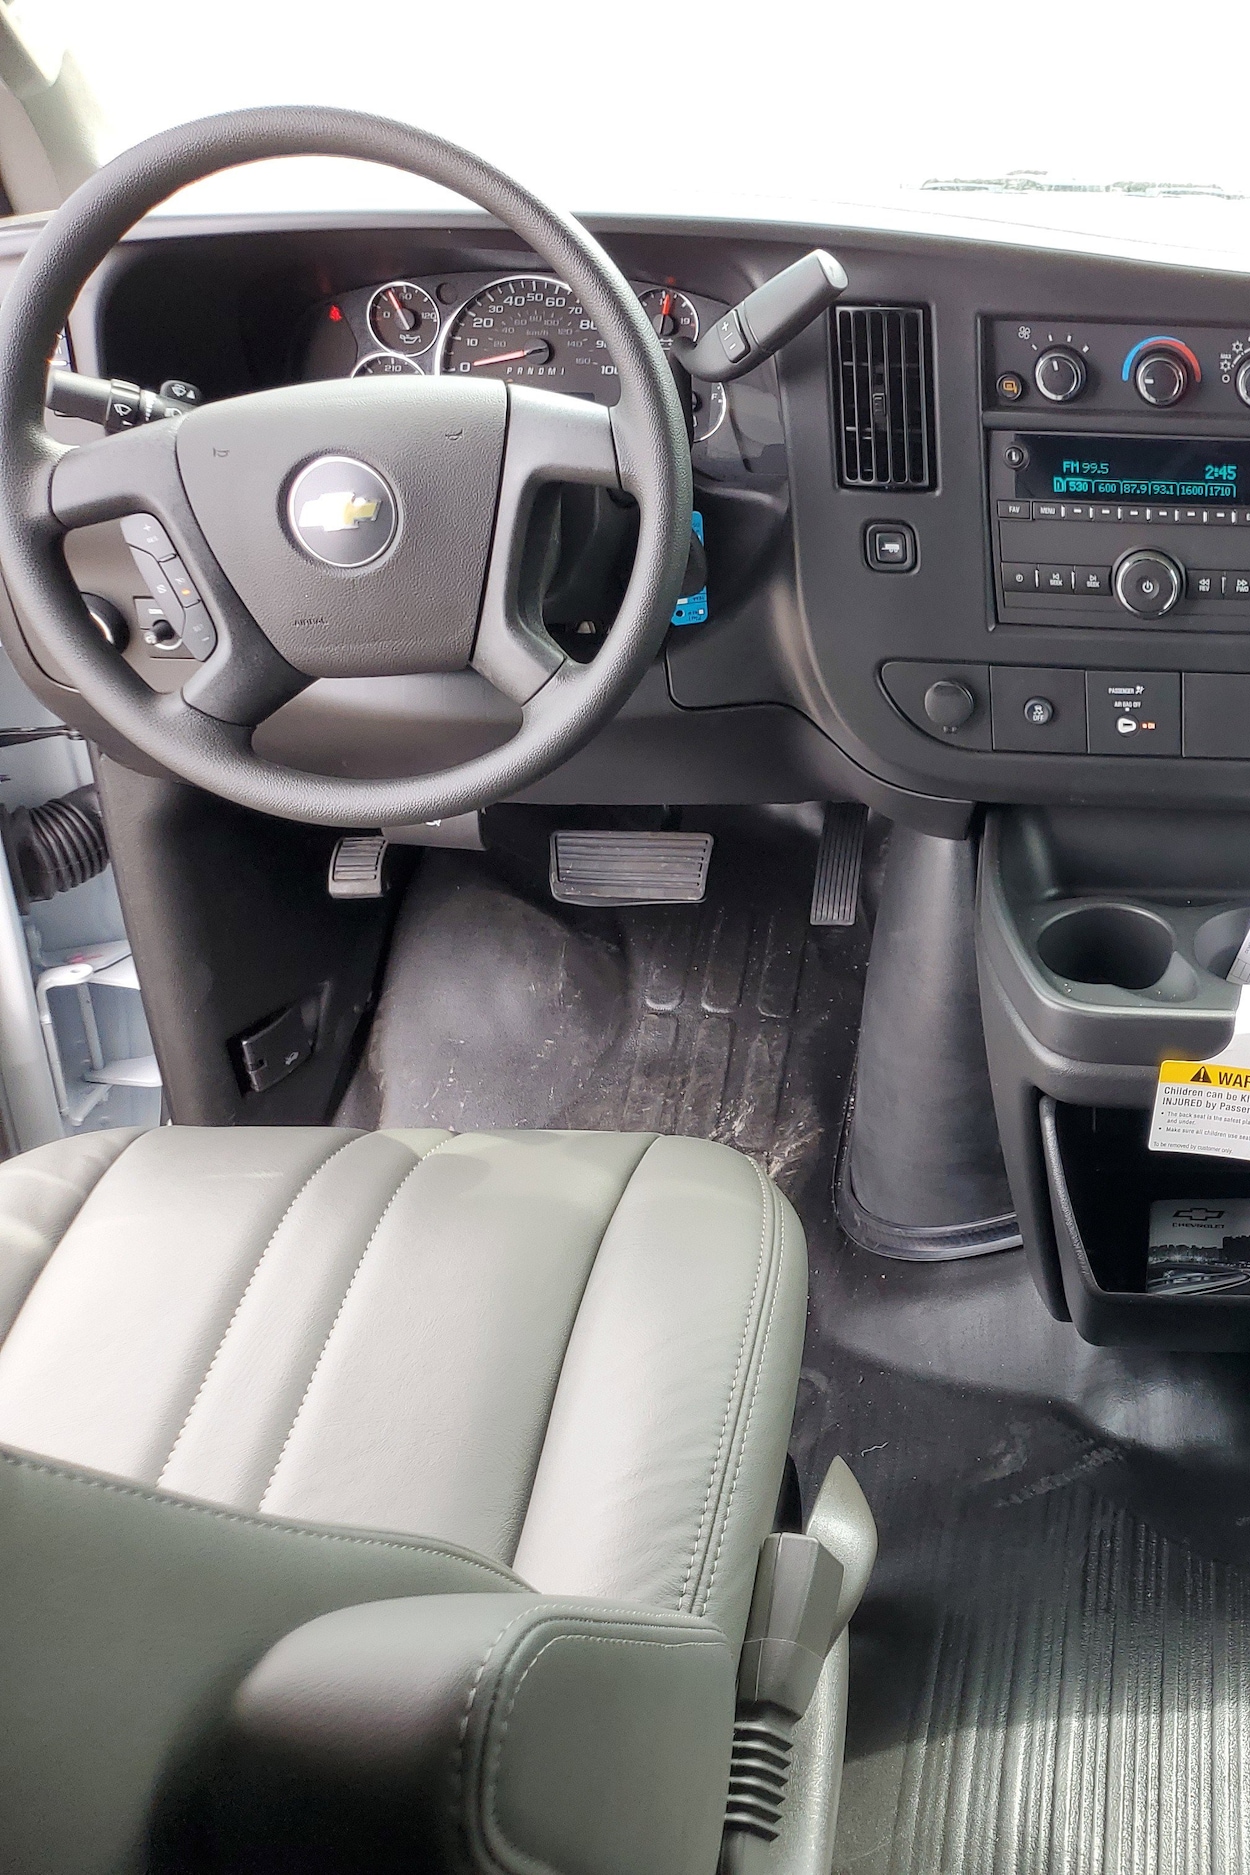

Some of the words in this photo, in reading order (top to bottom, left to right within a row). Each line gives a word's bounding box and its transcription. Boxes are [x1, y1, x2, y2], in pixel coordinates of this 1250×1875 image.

[504, 296, 525, 306] 40
[526, 293, 544, 302] 50
[546, 298, 566, 307] 60
[488, 305, 504, 314] 30
[568, 306, 582, 314] 70
[473, 318, 493, 328] 20
[466, 338, 478, 346] 10
[460, 363, 470, 372] 0
[1063, 461, 1079, 473] FM
[1082, 463, 1109, 474] 99.5
[1205, 465, 1237, 480] 2:45
[1069, 481, 1088, 492] 530
[1098, 483, 1116, 493] 600
[1124, 484, 1147, 494] 87.9
[1153, 485, 1173, 495] 93.1
[1181, 485, 1204, 495] 1600
[1209, 486, 1230, 496] 1710
[1164, 1086, 1205, 1097] Children
[1206, 1091, 1223, 1099] can
[1226, 1092, 1237, 1101] be
[1162, 1097, 1202, 1108] INJURED
[1206, 1101, 1217, 1110] by
